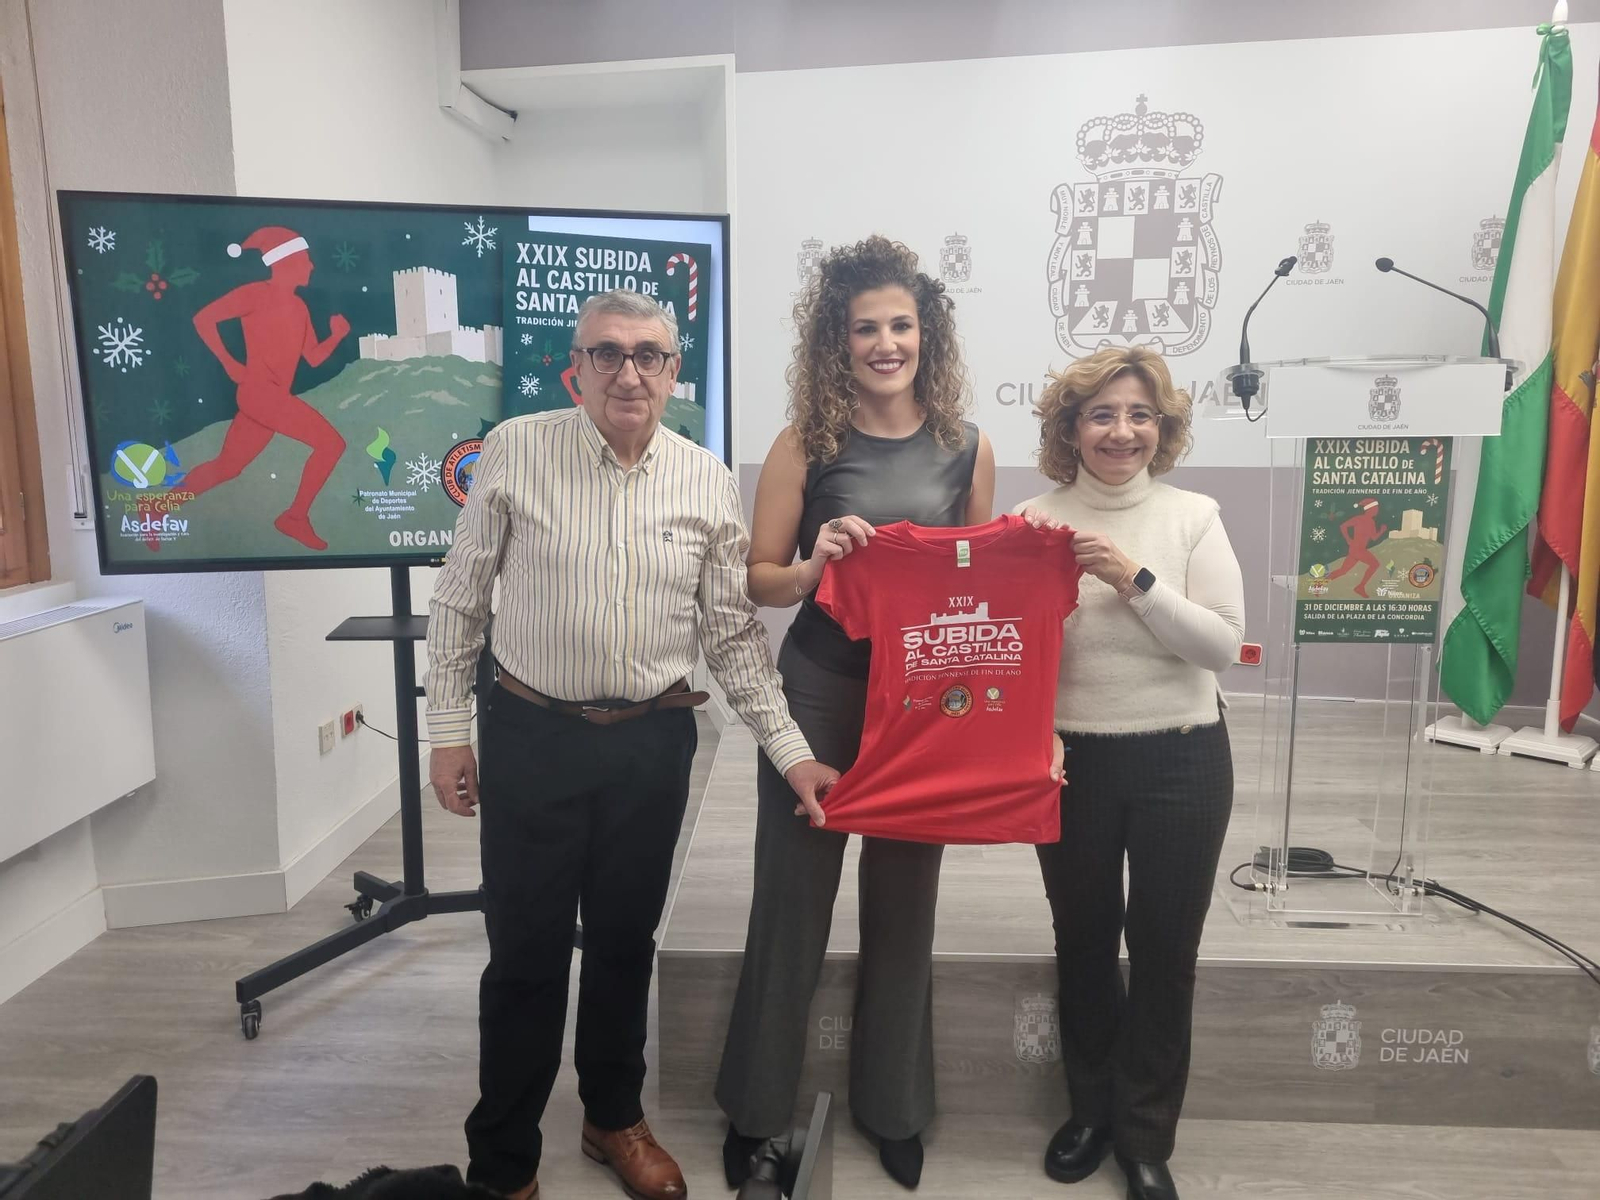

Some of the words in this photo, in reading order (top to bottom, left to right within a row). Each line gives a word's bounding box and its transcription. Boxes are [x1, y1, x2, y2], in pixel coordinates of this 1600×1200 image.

[516, 243, 568, 267] XXIX
[575, 247, 652, 273] SUBIDA
[516, 268, 540, 288] AL
[547, 270, 637, 293] CASTILLO
[642, 281, 659, 296] DE
[516, 291, 579, 314] SANTA
[516, 316, 564, 327] TRADICIÓN
[995, 382, 1041, 406] CIU
[449, 444, 481, 466] ATLETISM
[1314, 440, 1351, 454] XXIX
[1355, 440, 1410, 454] SUBIDA
[1314, 457, 1330, 469] AL
[1335, 456, 1399, 469] CASTILLO
[1402, 459, 1414, 469] DE
[446, 466, 453, 478] DE
[1312, 472, 1356, 485] SANTA
[1361, 472, 1426, 485] CATALINA
[106, 490, 132, 501] Una
[136, 491, 195, 503] esperanza
[389, 490, 417, 498] Municipal
[447, 480, 461, 498] CLUB
[1312, 487, 1345, 495] TRADICIÓN
[1413, 487, 1428, 495] AÑO
[125, 502, 151, 514] para
[155, 500, 180, 513] Celia
[375, 506, 415, 514] Ayuntamiento
[380, 498, 407, 506] Deportes
[120, 513, 188, 533] Asdefav
[389, 530, 453, 547] ORGAN
[948, 596, 974, 608] XXIX
[1304, 603, 1312, 611] 31
[1313, 603, 1323, 611] DE
[1324, 603, 1365, 611] DICIEMBRE
[1372, 604, 1386, 612] LAS
[1388, 604, 1407, 612] 16:30
[1408, 604, 1432, 612] HORAS
[903, 623, 1021, 650] SUBIDA
[905, 650, 926, 663] AL
[932, 641, 1023, 657] CASTILLO
[905, 661, 918, 671] DE
[921, 657, 960, 667] SANTA
[964, 653, 1022, 663] CATALINA
[818, 1015, 853, 1031] CIU
[818, 1034, 846, 1050] DE
[1381, 1028, 1464, 1046] CIUDAD
[1379, 1047, 1408, 1062] DE
[1413, 1044, 1469, 1064] JAÉN
